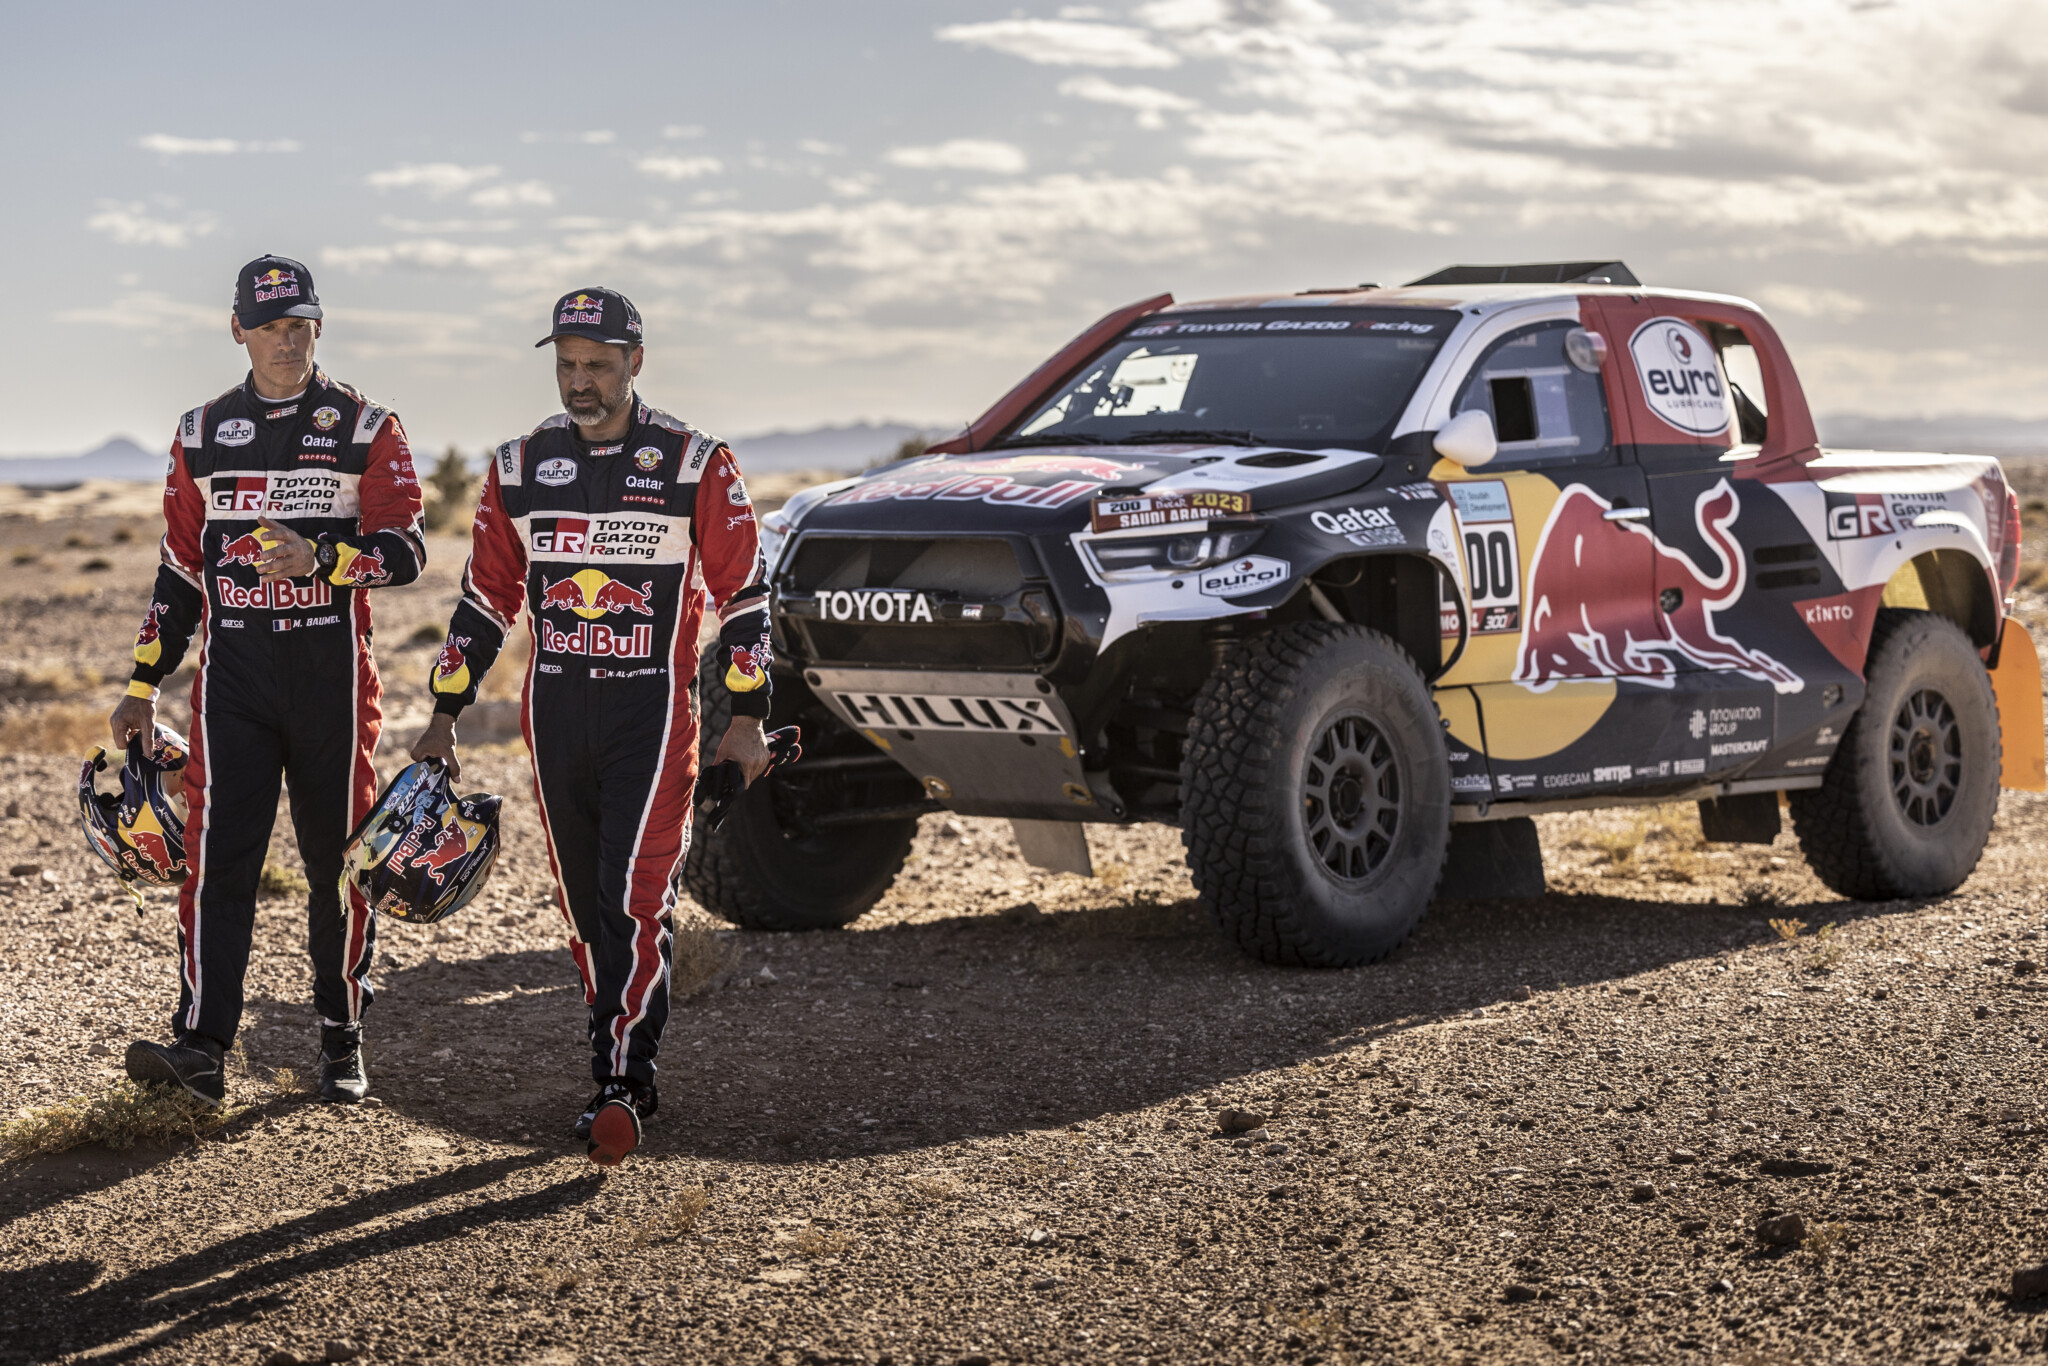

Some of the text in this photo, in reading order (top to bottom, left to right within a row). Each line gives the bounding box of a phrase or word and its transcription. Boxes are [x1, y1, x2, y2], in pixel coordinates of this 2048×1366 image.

[256, 284, 299, 302] Red Bull
[559, 311, 602, 325] Red Bull
[1176, 322, 1263, 333] TOYOTA
[1265, 320, 1351, 330] GAZOO
[1353, 320, 1434, 334] Racing
[218, 427, 251, 438] eurol
[302, 434, 338, 448] Qatar
[299, 454, 337, 462] ooredoo
[501, 443, 513, 474] sparco
[538, 467, 573, 477] eurol
[274, 477, 341, 489] TOYOTA
[625, 475, 664, 490] Qatar
[212, 490, 264, 510] GR
[270, 489, 335, 499] GAZOO
[623, 495, 665, 504] ooredoo
[825, 475, 1104, 509] Red Bull
[267, 500, 332, 513] Racing
[1110, 501, 1141, 512] 200
[1192, 493, 1243, 512] 2023
[596, 520, 669, 534] TOYOTA
[1119, 511, 1166, 528] SAUDI
[1310, 506, 1396, 534] Qatar
[1828, 504, 1894, 537] GR
[532, 531, 585, 553] GR
[592, 532, 661, 544] GAZOO
[590, 545, 656, 559] Racing
[1206, 567, 1281, 589] eurol
[217, 576, 269, 609] Red
[272, 576, 331, 610] Bull
[815, 590, 933, 623] TOYOTA
[221, 618, 244, 628] sparco
[293, 615, 341, 628] M. BAUMEL
[1440, 612, 1479, 630] MOL
[542, 618, 653, 658] Red Bull
[539, 663, 562, 673] sparco
[836, 692, 1063, 732] HILUX
[1711, 738, 1769, 756] MASTERCRAFT
[1543, 772, 1590, 788] EDGECAM
[405, 814, 437, 848] Red
[121, 850, 151, 875] Red
[387, 841, 417, 875] Bull
